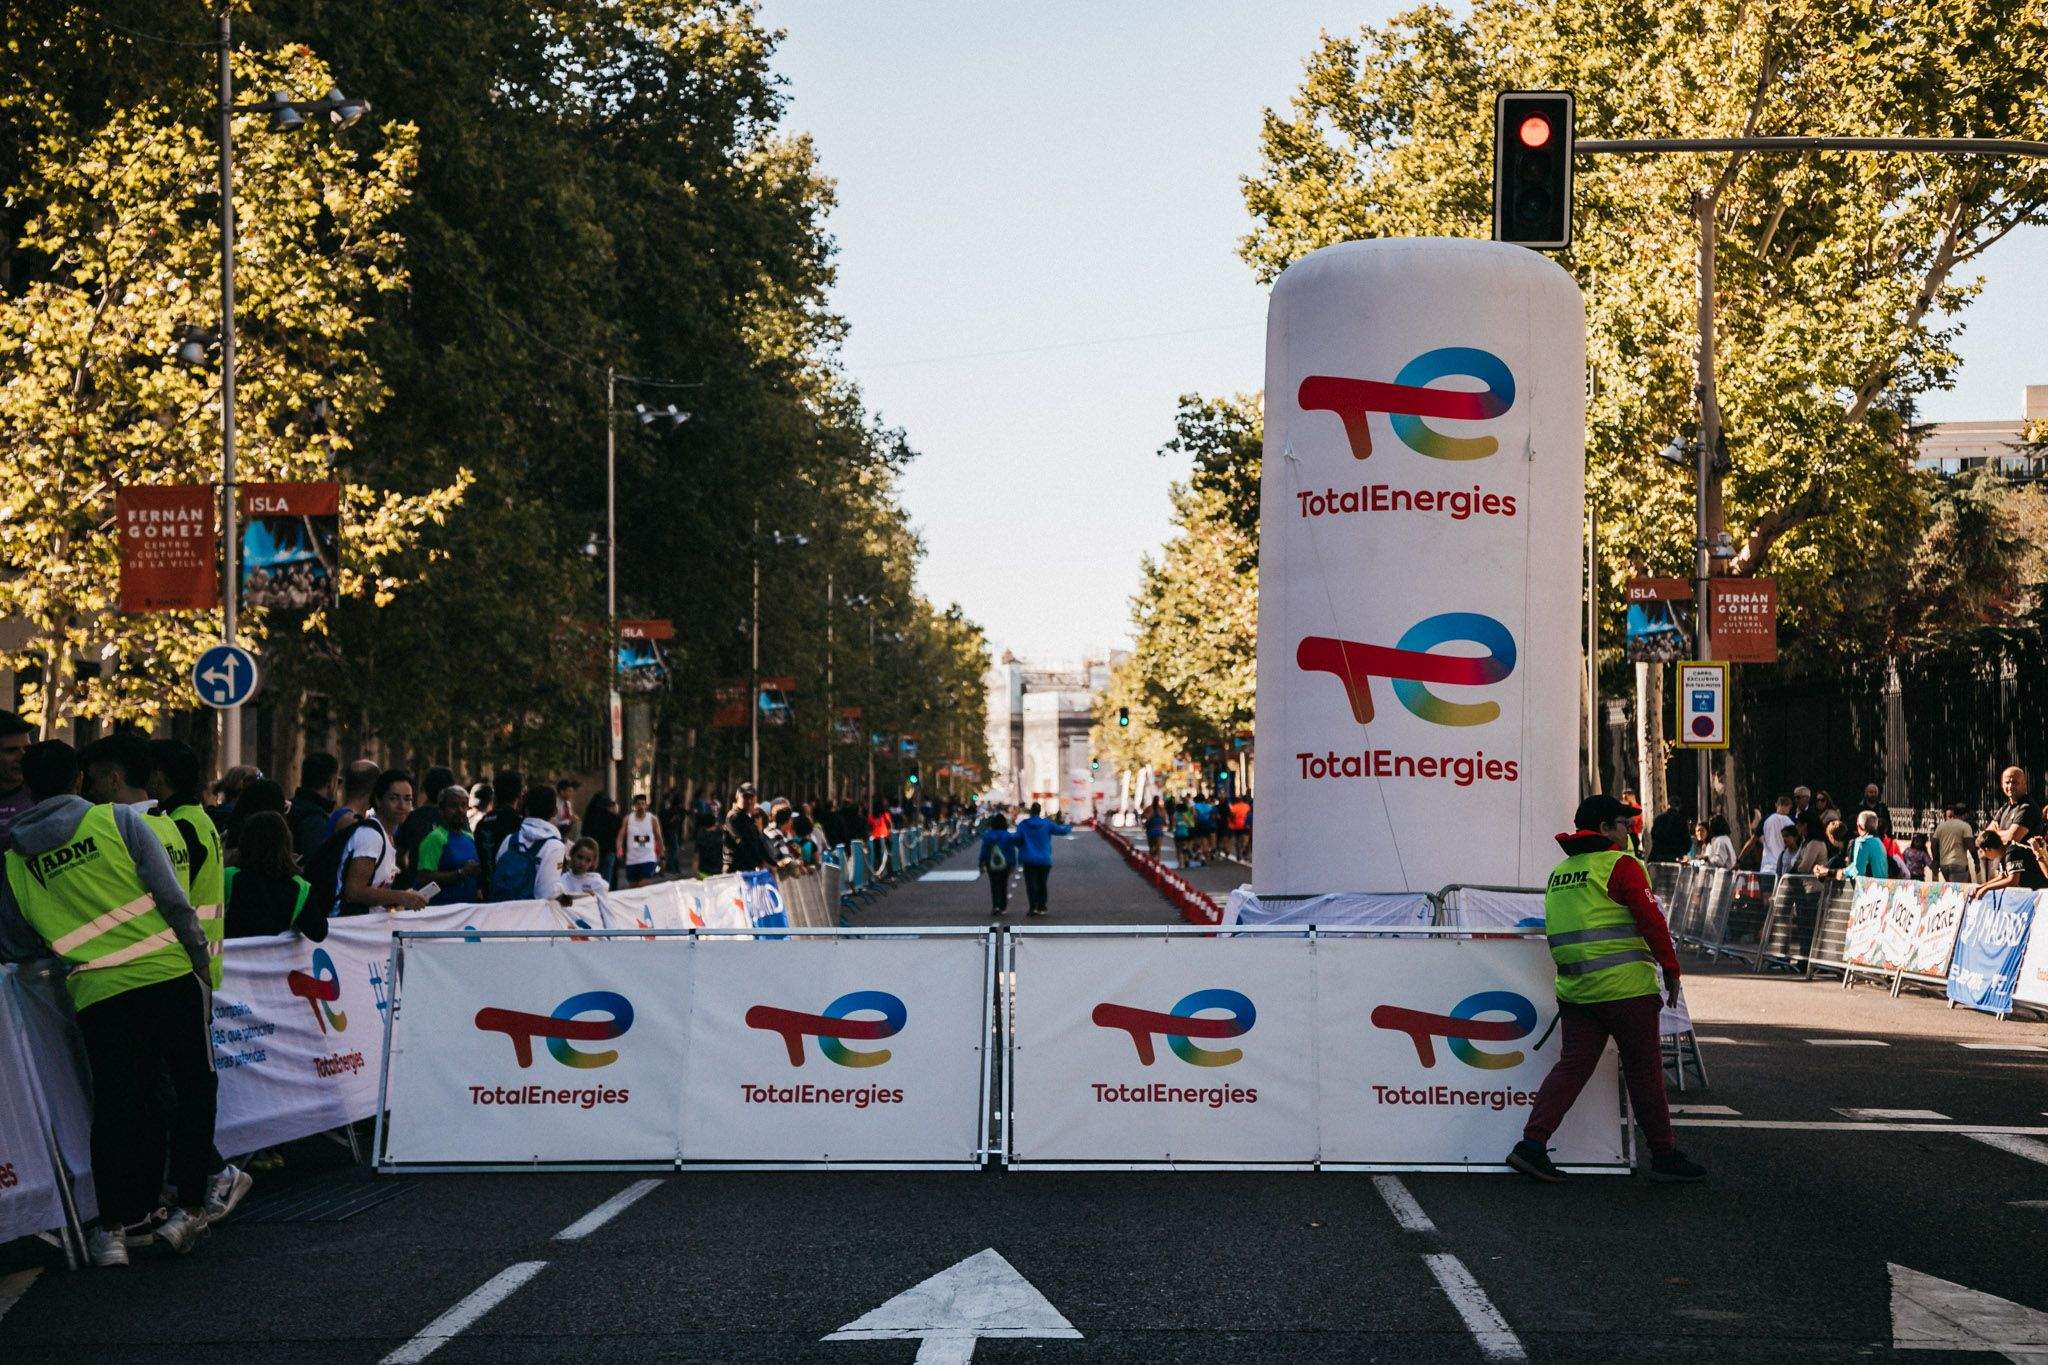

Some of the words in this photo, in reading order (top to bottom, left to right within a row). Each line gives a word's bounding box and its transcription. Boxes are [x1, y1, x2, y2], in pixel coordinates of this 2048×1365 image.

[249, 497, 289, 512] ISLA
[1297, 485, 1517, 520] TotalEnergies
[127, 505, 204, 523] FERNÁN
[127, 524, 204, 539] GÓMEZ
[144, 541, 190, 549] CENTRO
[137, 550, 197, 559] CULTURAL
[130, 560, 144, 568] DE
[150, 560, 165, 568] LA
[171, 560, 204, 568] VILLA
[1630, 588, 1658, 599] ISLA
[1718, 592, 1769, 603] FERNÁN
[1718, 603, 1769, 614] GÓMEZ
[621, 627, 644, 638] ISLA
[1297, 750, 1518, 785] TotalEnergies
[41, 836, 98, 874] ADM
[1551, 870, 1590, 888] ADM
[228, 1030, 242, 1045] que
[313, 1049, 365, 1079] TotalEnergies
[469, 1085, 629, 1109] TotalEnergies
[741, 1084, 904, 1108] TotalEnergies
[1091, 1083, 1258, 1108] TotalEnergies
